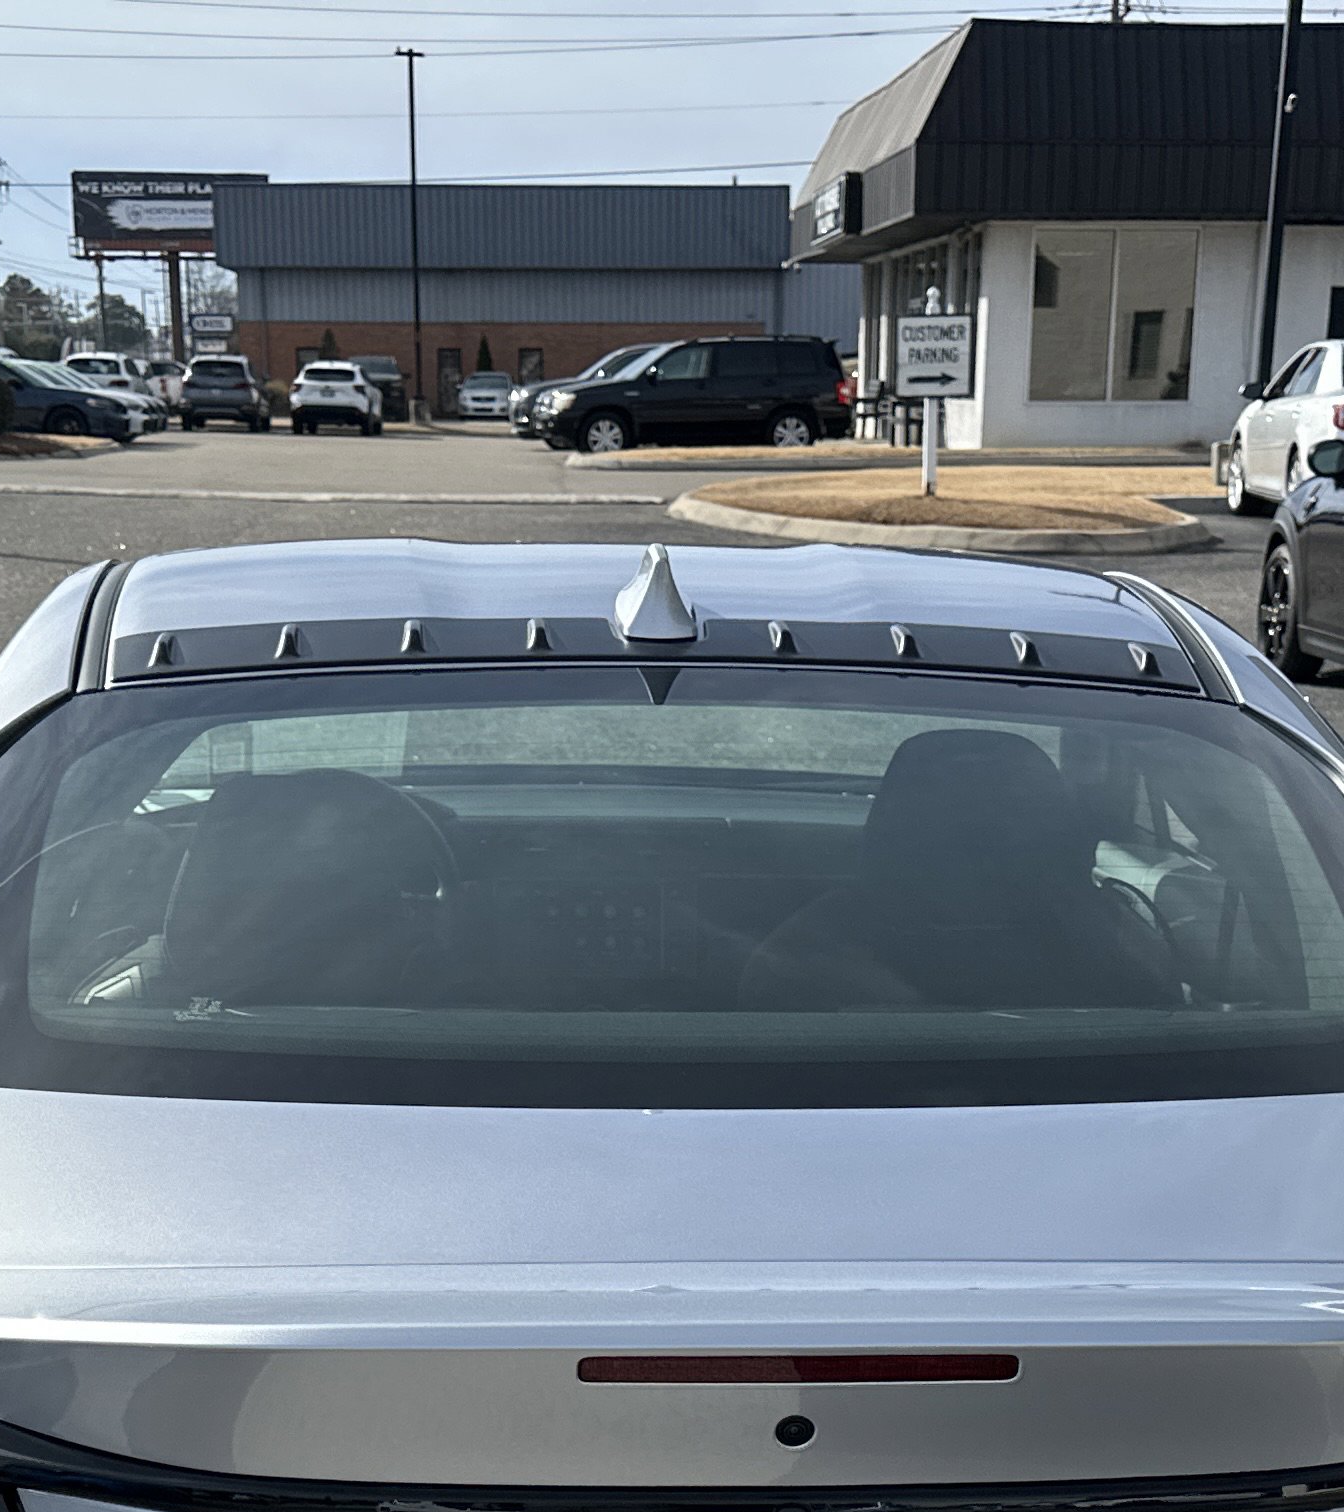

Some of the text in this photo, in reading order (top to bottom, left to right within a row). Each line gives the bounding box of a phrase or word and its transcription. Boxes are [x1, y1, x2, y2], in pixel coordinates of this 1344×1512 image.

[77, 182, 99, 194] WE
[101, 182, 145, 195] KNOW
[148, 183, 186, 195] THEIR
[901, 325, 966, 342] CUSTOMER
[907, 346, 961, 365] PARKING
